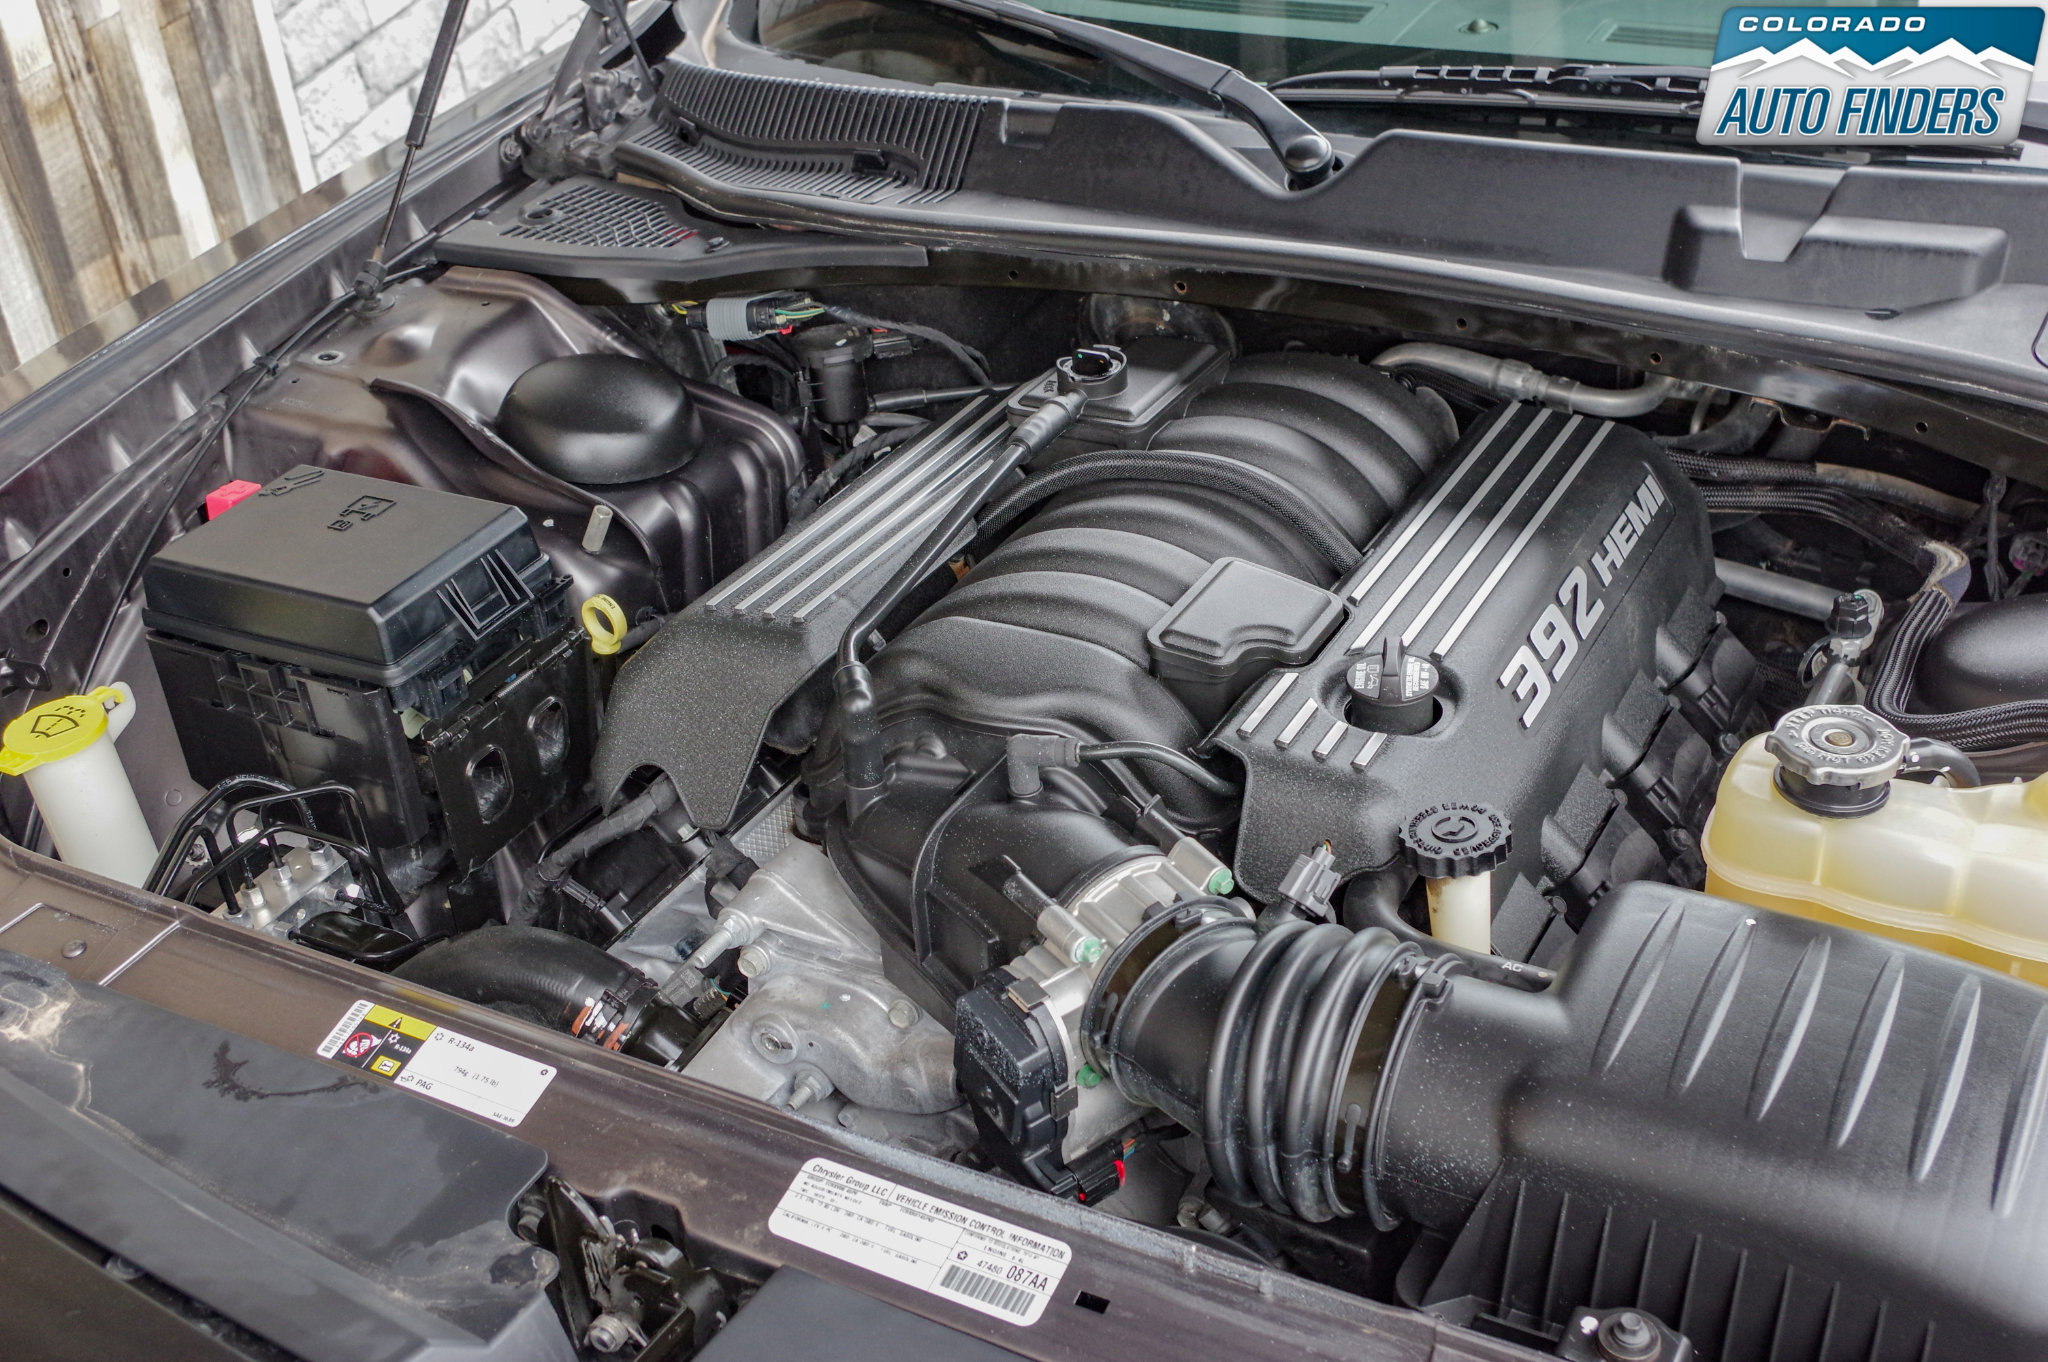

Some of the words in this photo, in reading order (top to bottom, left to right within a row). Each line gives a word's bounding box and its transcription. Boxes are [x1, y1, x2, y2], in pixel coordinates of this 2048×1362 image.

[1498, 566, 1605, 728] 392
[1589, 474, 1665, 587] HEMI
[1818, 754, 1849, 764] NOT
[1442, 802, 1486, 814] POWER
[1453, 829, 1501, 856] APPROVED
[1502, 961, 1524, 973] AC
[448, 1037, 475, 1052] R-134a
[454, 1066, 469, 1077] 794g
[472, 1073, 489, 1084] (175
[416, 1079, 433, 1091] PAG
[813, 1164, 845, 1181] Chrysler
[846, 1175, 870, 1191] Group
[871, 1184, 888, 1197] LLC
[895, 1193, 929, 1212] VEHICLE
[930, 1204, 967, 1225] EMISSION
[969, 1219, 1006, 1239] CONTROL
[1009, 1233, 1065, 1259] INFORMATION
[1006, 1265, 1048, 1291] 087AA
